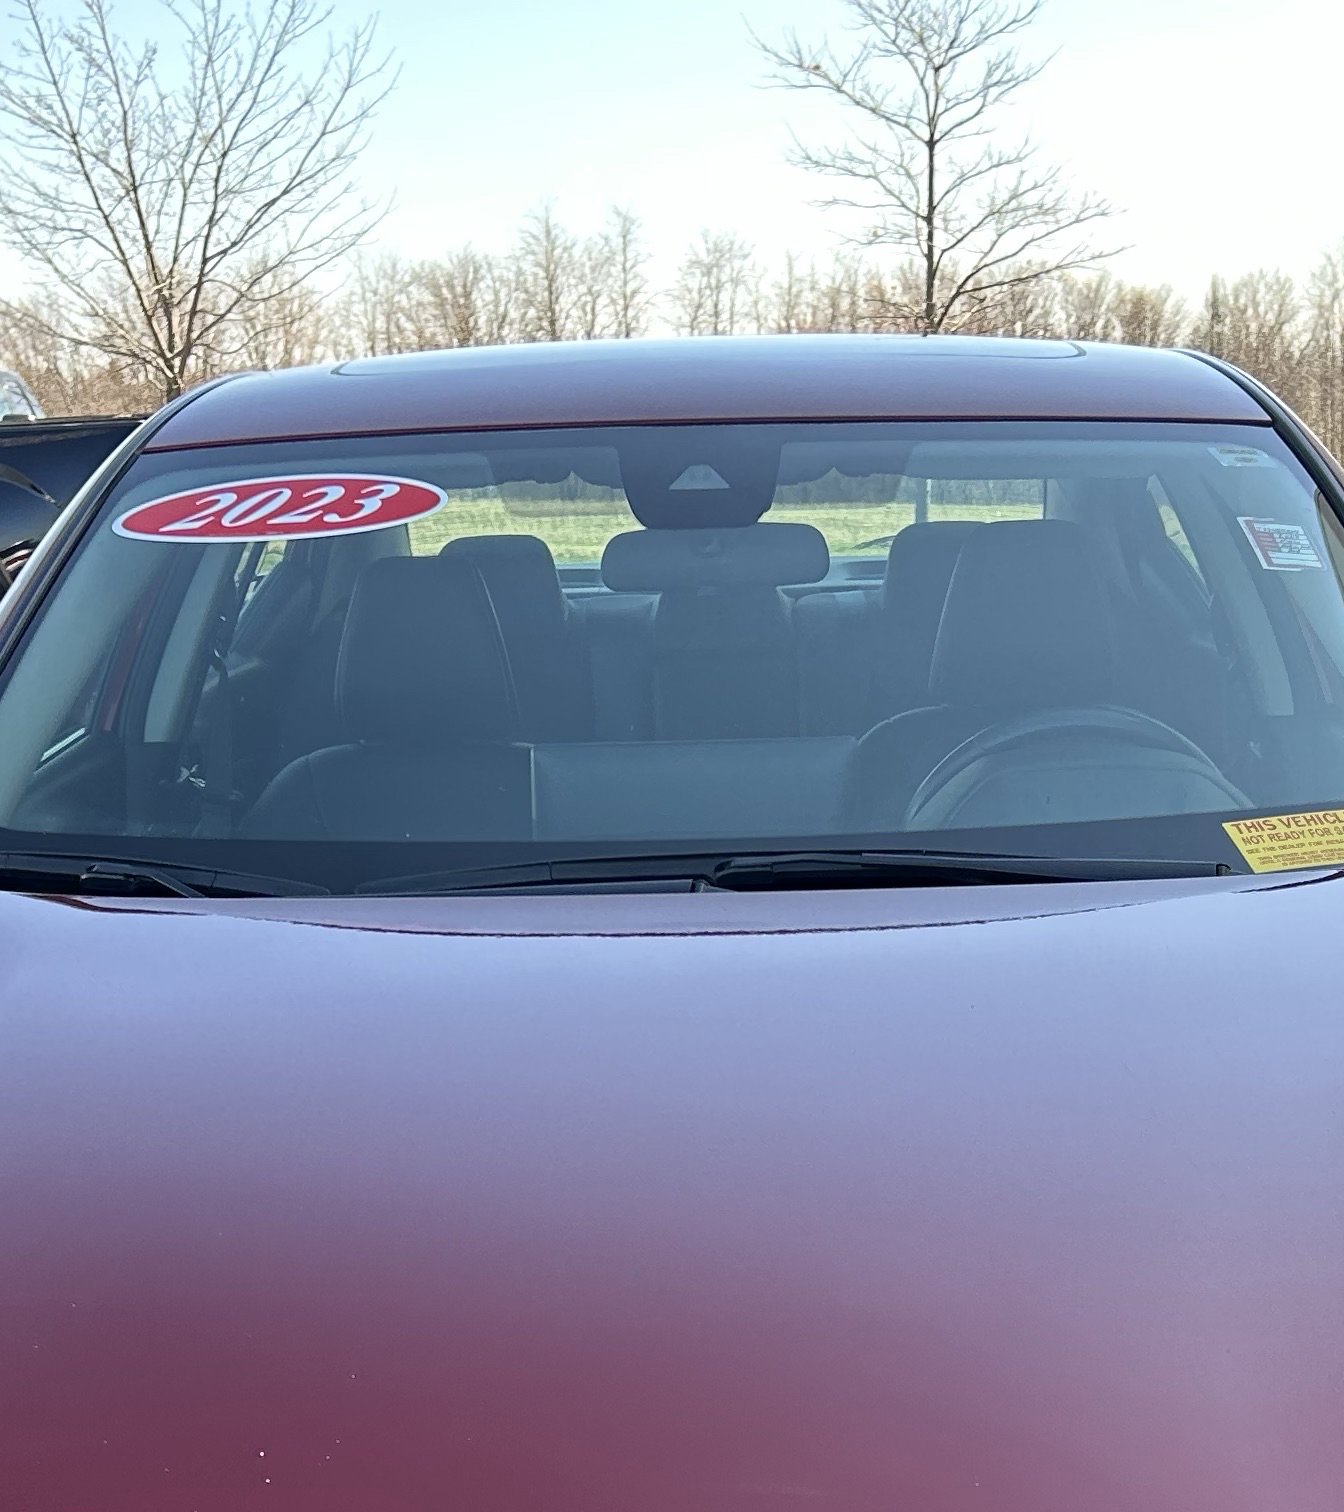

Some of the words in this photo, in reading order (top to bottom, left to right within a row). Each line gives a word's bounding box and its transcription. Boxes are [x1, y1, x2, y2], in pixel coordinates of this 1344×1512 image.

[157, 482, 401, 533] 2023
[1230, 819, 1277, 835] THIS
[1241, 835, 1266, 847] NOT
[1267, 831, 1307, 843] READY
[1308, 827, 1331, 839] FOR
